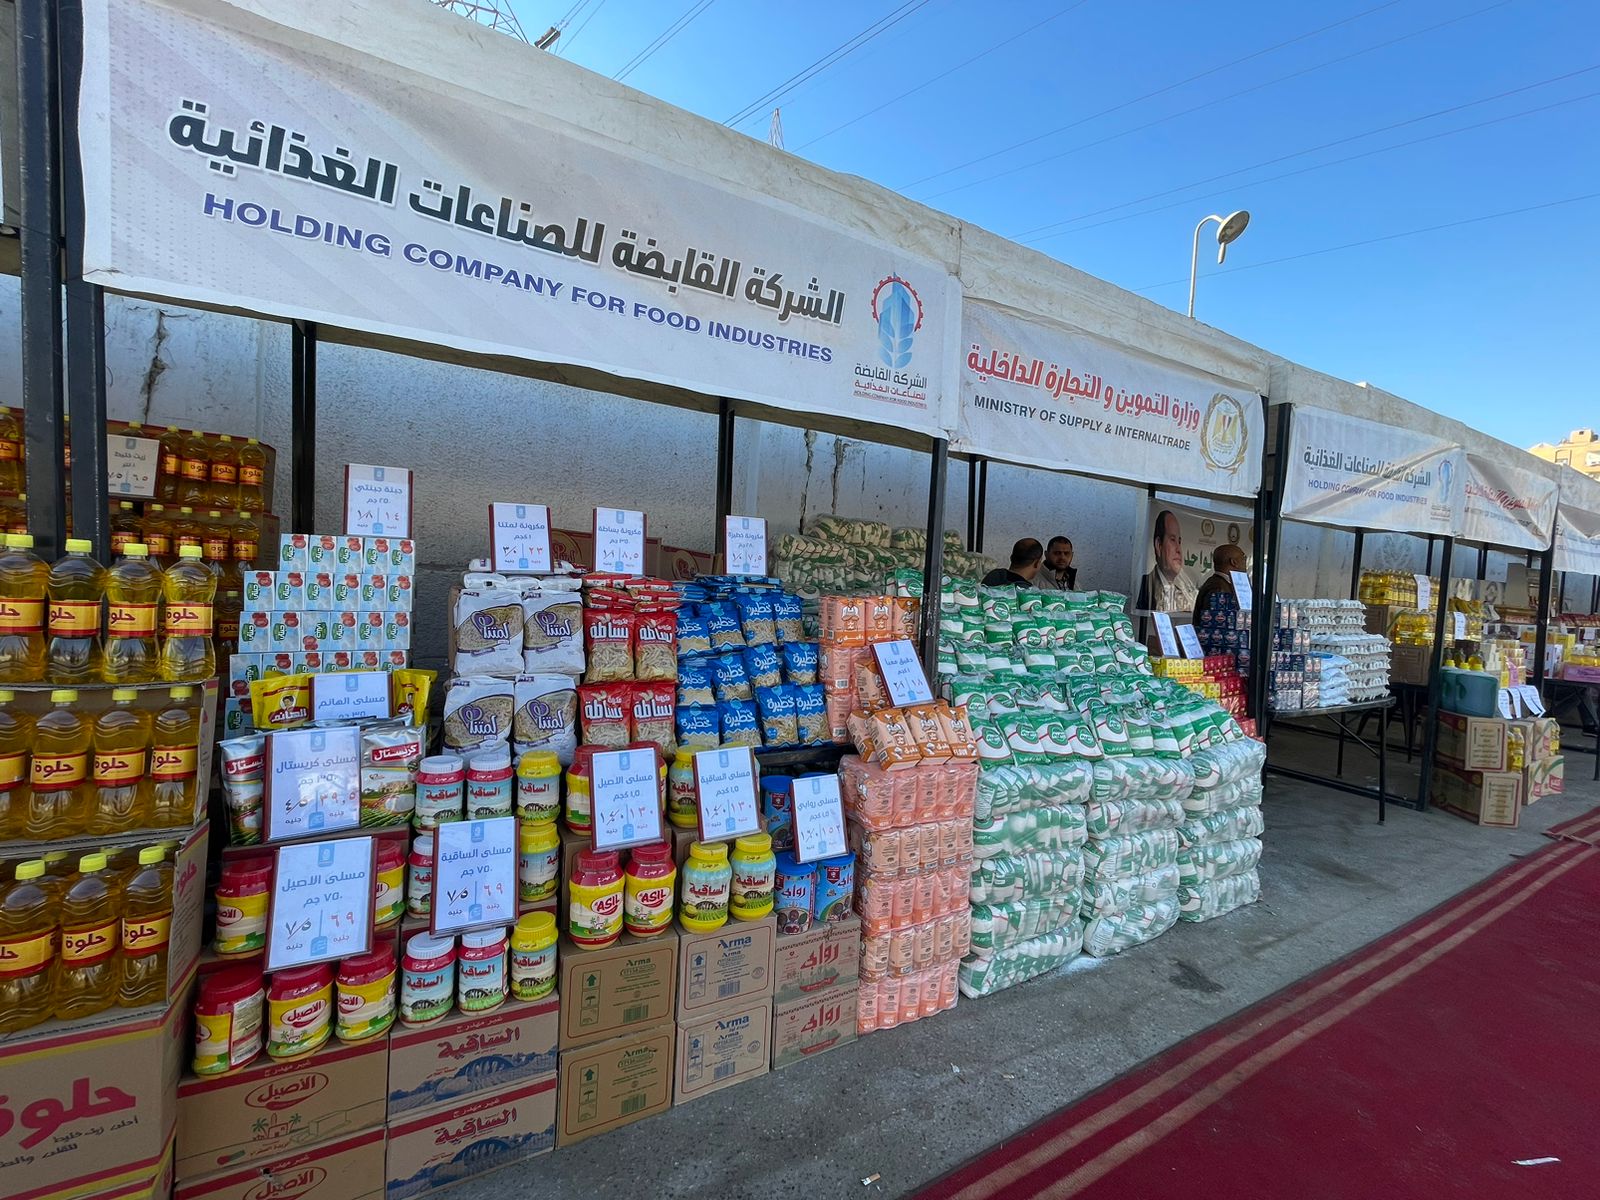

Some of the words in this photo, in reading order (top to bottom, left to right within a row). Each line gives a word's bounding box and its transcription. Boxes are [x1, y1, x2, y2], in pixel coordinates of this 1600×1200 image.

[168, 100, 399, 205] الغذائية
[409, 179, 605, 263] للصناعات
[612, 229, 741, 297] القابضة
[203, 193, 392, 257] HOLDING
[403, 243, 564, 297] COMPANY
[571, 286, 627, 315] FOR
[633, 302, 701, 333] FOOD
[708, 320, 833, 363] INDUSTRIES
[744, 266, 846, 326] الشركة
[854, 363, 891, 382] القابضة
[967, 344, 1044, 387] الداخلية
[893, 371, 928, 390] الشركة
[1044, 363, 1101, 401] التجارة
[1103, 387, 1113, 410] و
[1114, 388, 1169, 418] التموين
[974, 394, 1037, 420] MINISTRY
[1039, 409, 1057, 422] OF
[1058, 413, 1103, 433] SUPPLY
[1104, 423, 1112, 433] &
[1114, 424, 1191, 451] INTERNALTRADE
[1171, 399, 1200, 431] وزارة
[1303, 446, 1343, 471] الغذائية
[1308, 479, 1341, 492] HOLDING
[1377, 490, 1395, 501] FOOD
[520, 522, 546, 531] مكرونة
[598, 526, 620, 534] بساطة
[620, 527, 642, 536] مكرونة
[166, 606, 199, 625] حلوة
[589, 621, 629, 640] بساطة
[717, 665, 745, 682] خطيرة
[318, 698, 350, 710] الهانم
[352, 695, 386, 706] مسلى
[633, 698, 673, 719] بساطة
[767, 696, 795, 713] خطيرة
[584, 699, 624, 720] بساطة
[680, 717, 712, 730] خطيرة
[724, 710, 756, 727] خطيرة
[35, 758, 75, 779] حلوة
[276, 758, 320, 774] كريستال
[322, 754, 358, 767] مسلى
[597, 776, 625, 789] الاصيل
[626, 772, 654, 786] مسلى
[700, 773, 727, 785] الساقية
[726, 770, 751, 782] مسلى
[425, 786, 462, 801] الساقية
[469, 785, 501, 800] الساقية
[519, 780, 550, 795] الساقية
[612, 791, 629, 802] كجم
[817, 797, 839, 807] مسلى
[441, 848, 479, 863] الساقية
[480, 845, 512, 859] مسلى
[324, 870, 366, 884] مسلى
[460, 869, 475, 879] جم
[735, 873, 770, 888] الساقية
[281, 875, 322, 893] الاصيل
[688, 882, 727, 897] الساقية
[303, 896, 321, 909] جم
[596, 894, 620, 912] ASIL
[641, 889, 666, 903] ASIL
[330, 911, 354, 928] ٦٩
[447, 908, 463, 916] جنيه
[65, 933, 107, 954] حلوة
[285, 942, 304, 951] جنيه
[332, 933, 350, 943] جنيه
[717, 935, 752, 950] Arma
[513, 954, 546, 969] الساقية
[625, 957, 652, 967] Arma
[460, 963, 496, 979] الساقية
[406, 975, 444, 991] الساقية
[714, 1014, 750, 1031] Arma
[437, 1025, 521, 1060] الساقية
[433, 1106, 518, 1146] الساقية
